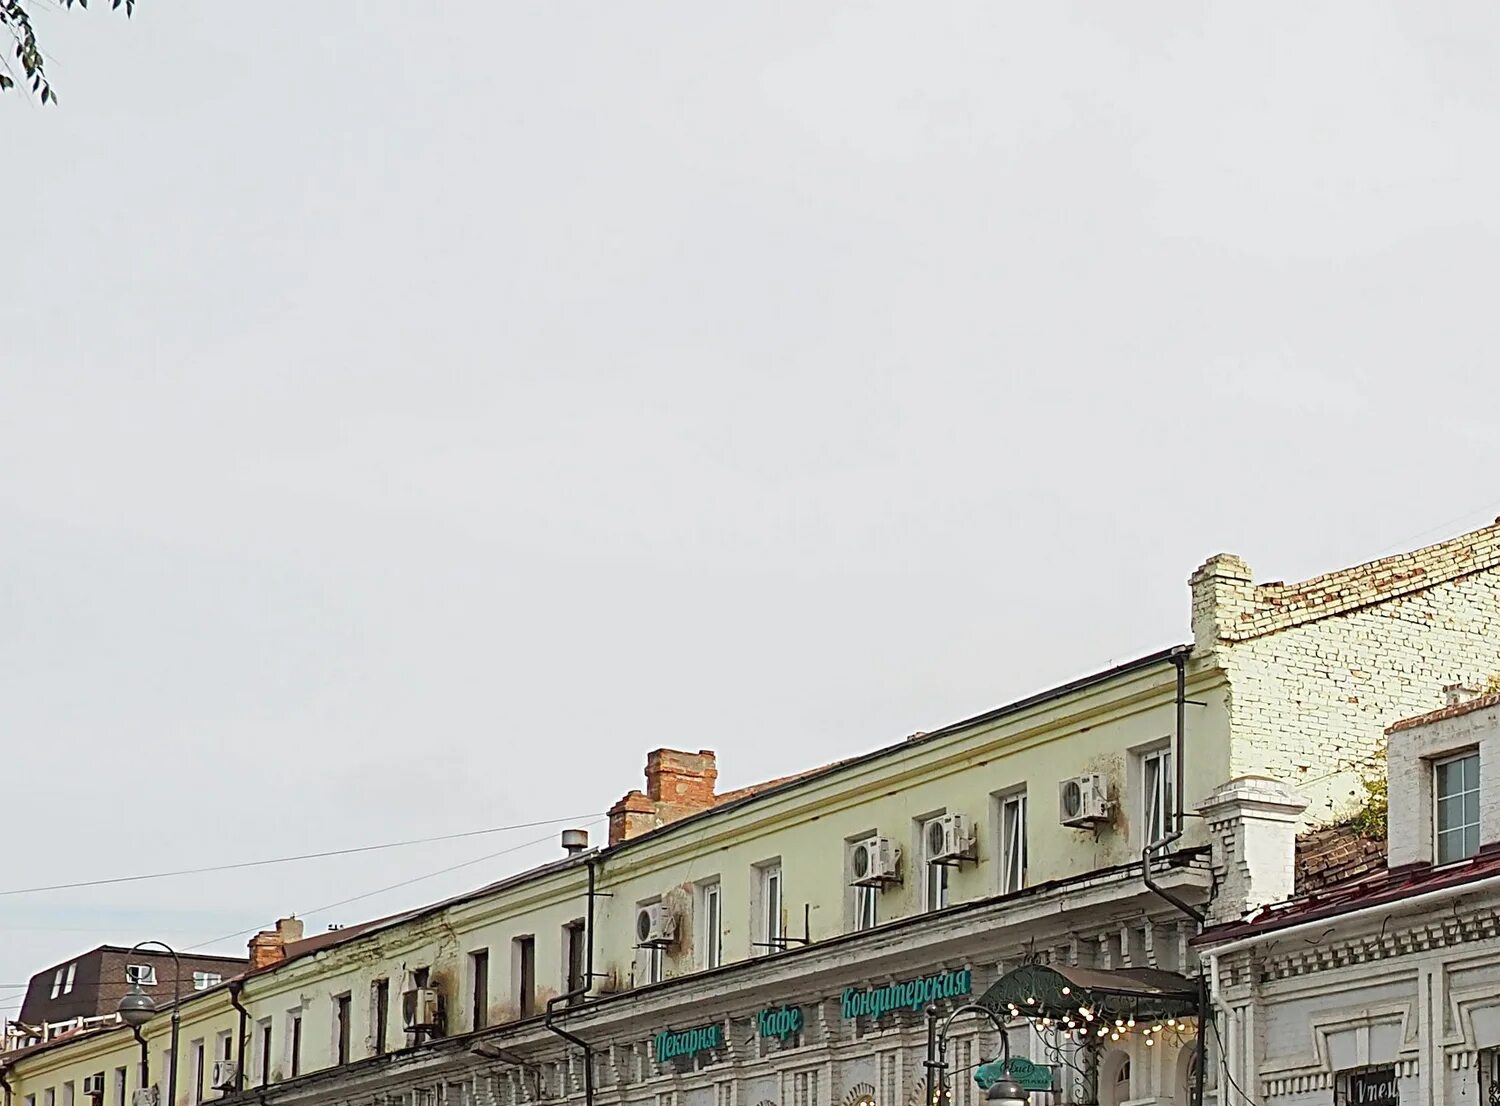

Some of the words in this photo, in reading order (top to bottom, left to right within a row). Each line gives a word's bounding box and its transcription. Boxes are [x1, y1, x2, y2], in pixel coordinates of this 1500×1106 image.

[841, 968, 970, 1020] Кондитерская
[756, 1006, 800, 1041] Кафе
[654, 1024, 720, 1063] Пекарня
